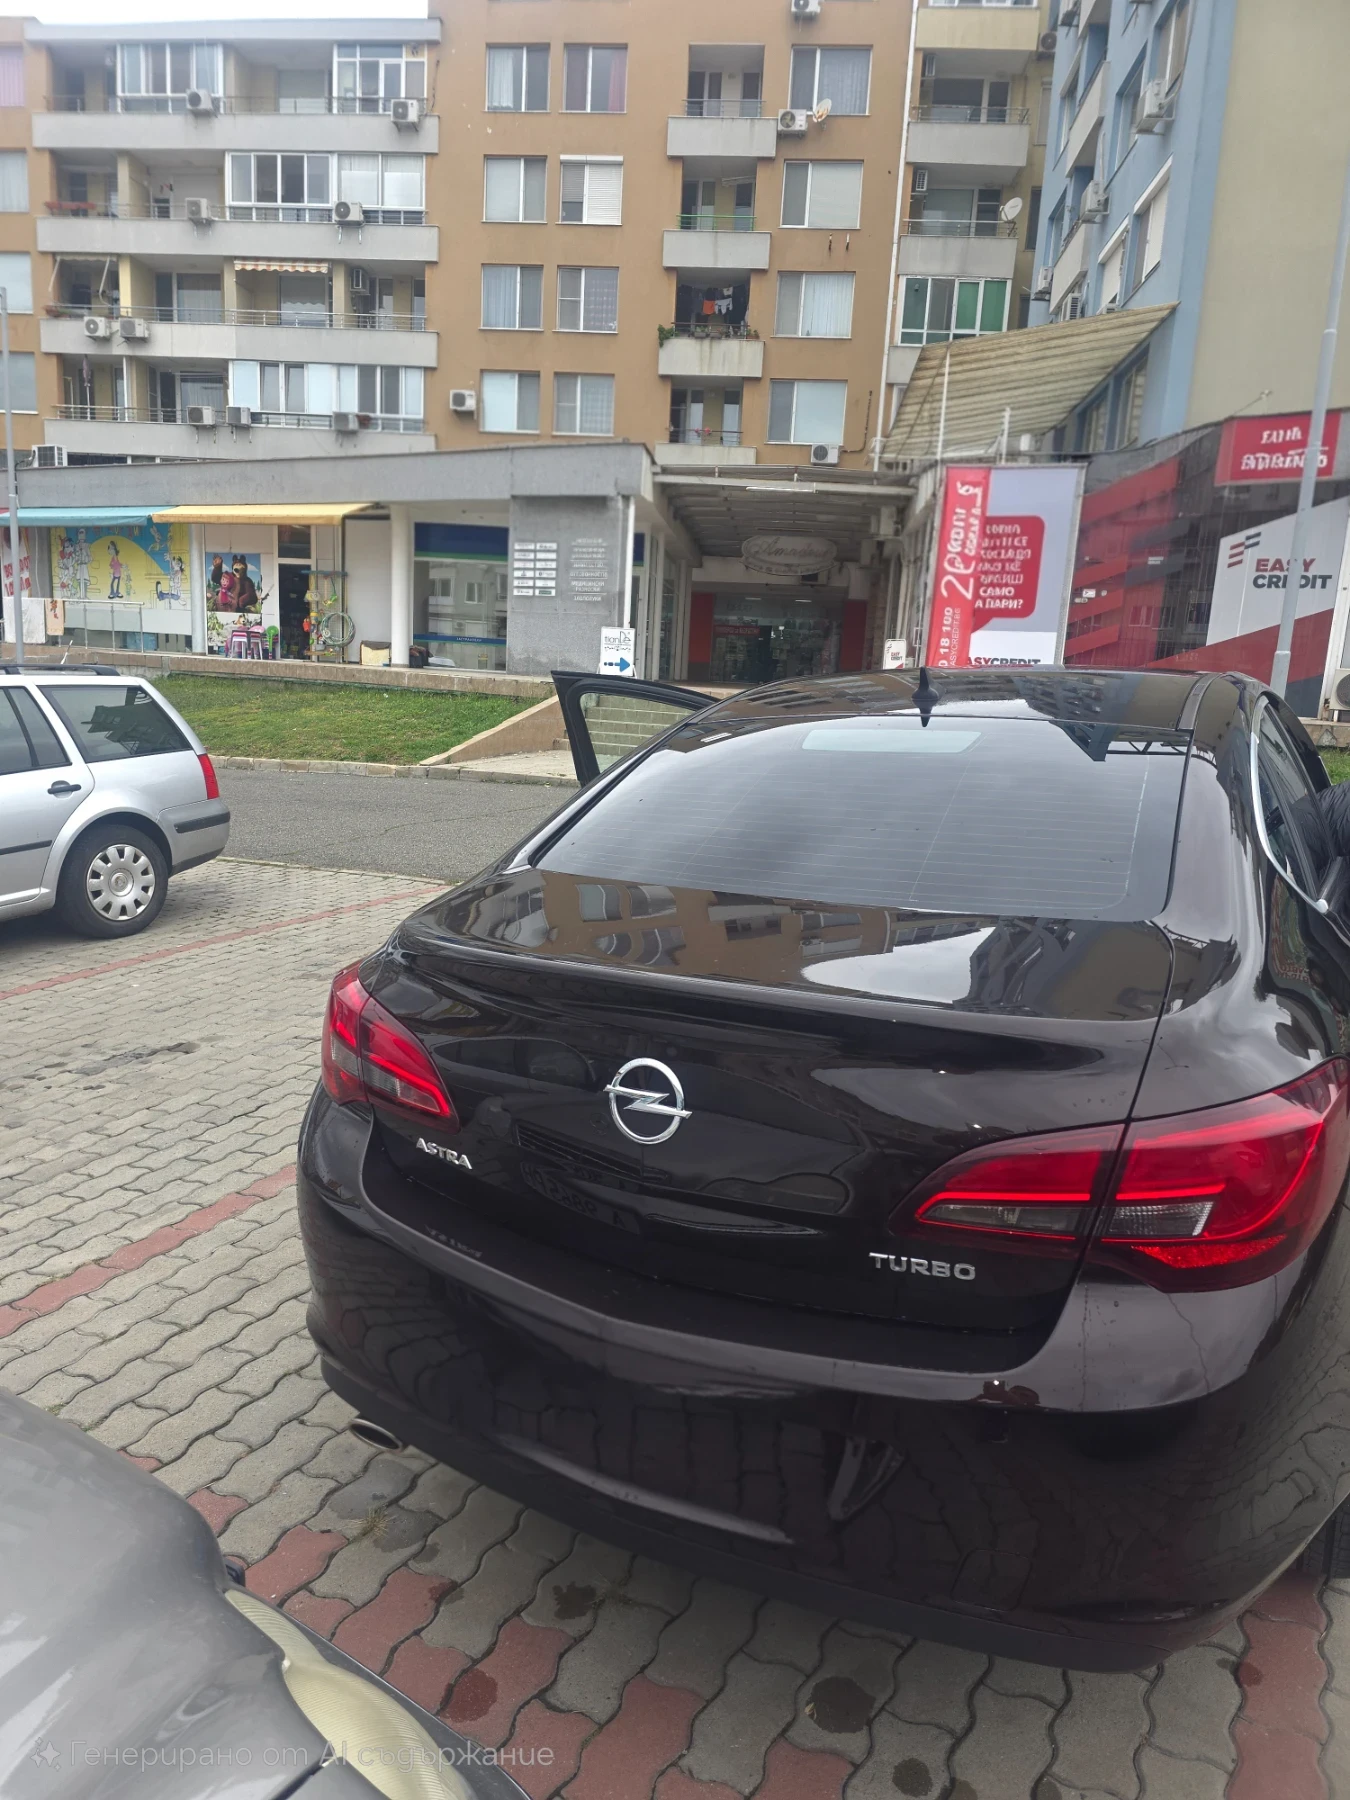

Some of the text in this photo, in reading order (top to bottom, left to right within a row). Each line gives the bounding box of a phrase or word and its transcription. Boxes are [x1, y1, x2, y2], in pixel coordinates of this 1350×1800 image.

[1255, 558, 1316, 573] EAY
[979, 586, 1015, 596] САМО
[985, 599, 1024, 609] ПАРИ?
[943, 607, 953, 633] 100
[951, 607, 961, 666] ASYCREDIT.BG
[939, 637, 950, 654] 18
[966, 657, 1041, 665] ASYCREDIT
[416, 1137, 473, 1170] ASTRA
[868, 1252, 976, 1281] TURBO
